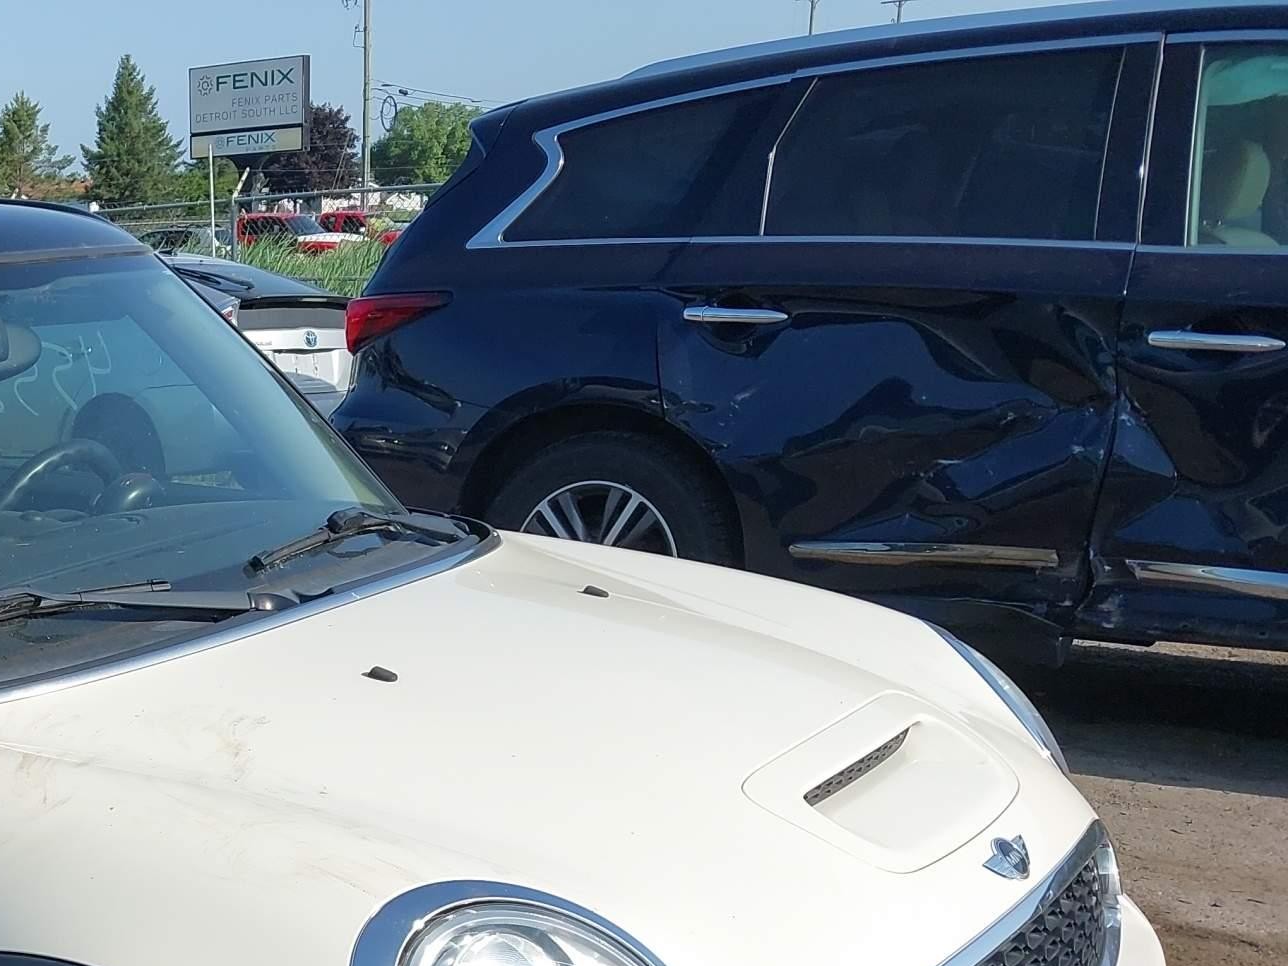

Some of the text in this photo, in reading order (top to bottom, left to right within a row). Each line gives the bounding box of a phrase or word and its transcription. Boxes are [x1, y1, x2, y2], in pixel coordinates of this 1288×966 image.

[215, 67, 295, 92] FENIX
[231, 92, 298, 108] FENIX PARTS
[195, 104, 298, 123] DETROIT SOUTH LLC
[225, 131, 276, 147] FENIX
